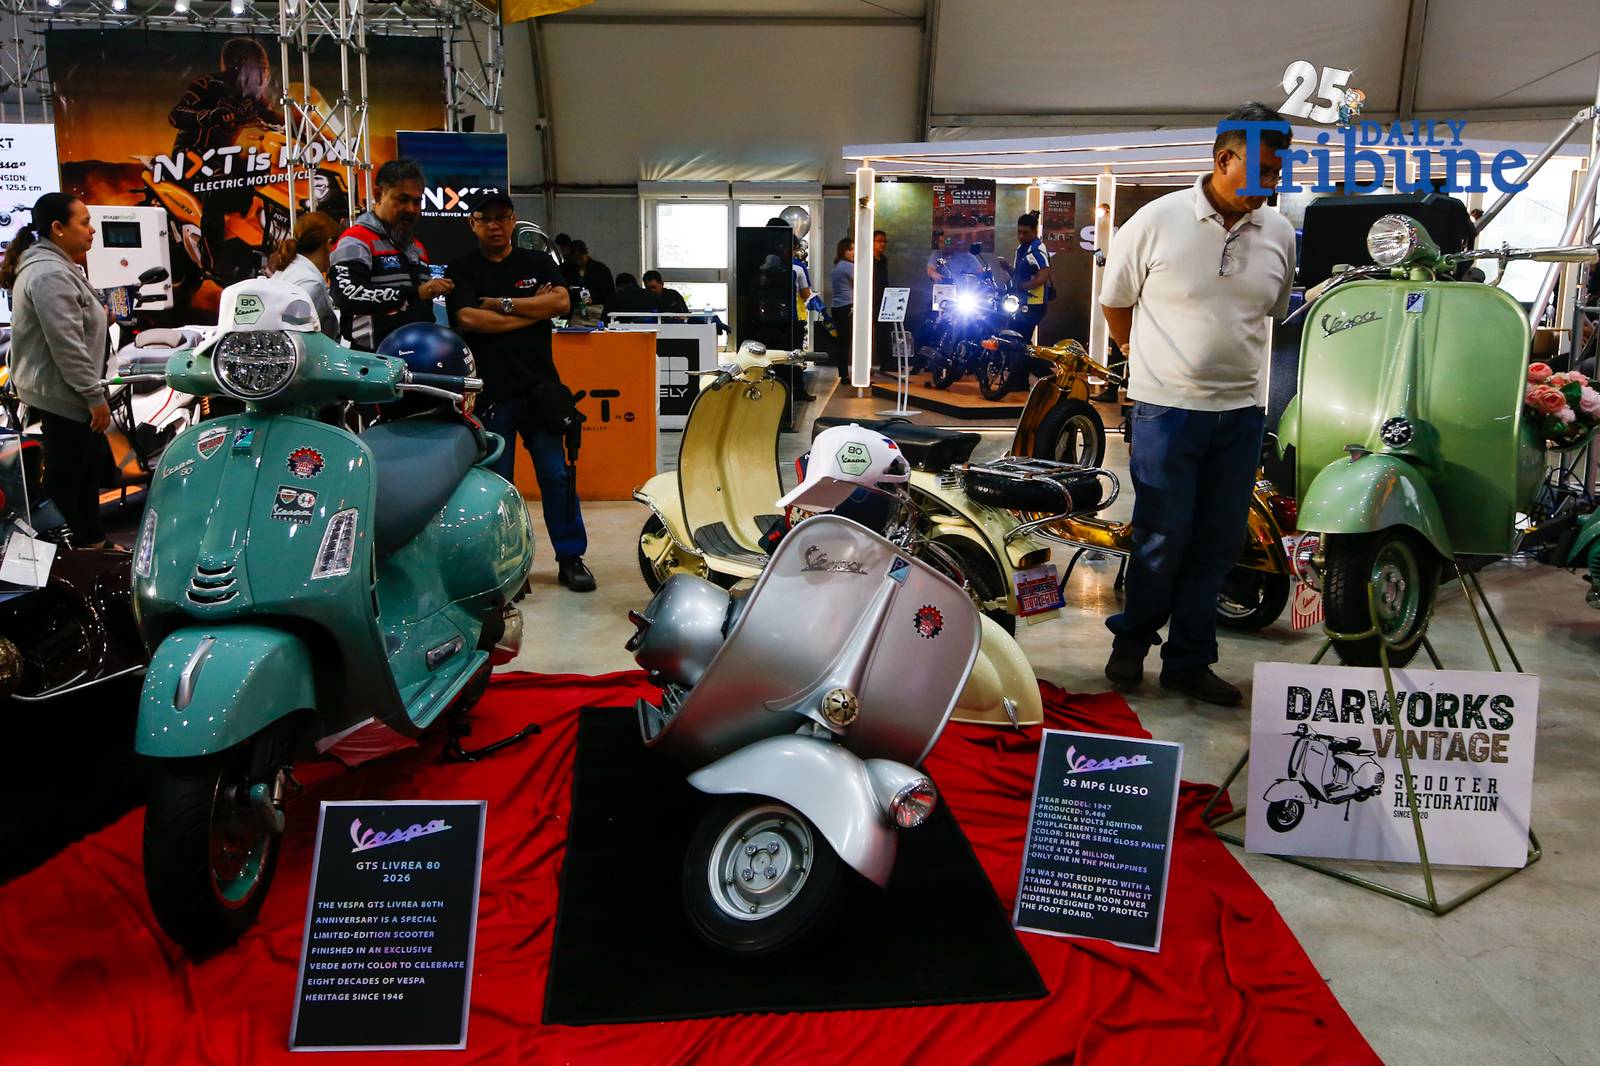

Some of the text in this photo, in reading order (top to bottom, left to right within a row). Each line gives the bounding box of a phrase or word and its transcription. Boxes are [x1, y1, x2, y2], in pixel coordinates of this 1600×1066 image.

[153, 145, 242, 183] NXT
[246, 146, 271, 172] is
[193, 177, 244, 193] ELECTRIC
[1321, 311, 1383, 339] Vespa
[847, 446, 862, 455] 80
[161, 458, 196, 480] Vespa
[273, 503, 312, 516] Vespa
[1285, 685, 1515, 731] DARWORKS
[1372, 728, 1511, 763] VINTAGE
[1066, 745, 1153, 774] Vespa
[1062, 778, 1149, 796] 98 MP6 LUSSO
[1395, 774, 1498, 794] SCOOTER
[1061, 798, 1091, 808] MODEL:
[1093, 803, 1112, 811] 1947
[1394, 792, 1499, 811] RESTORATION
[1393, 810, 1411, 818] SINCE
[1080, 817, 1104, 826] VOLTS
[1106, 820, 1143, 831] IGNITION
[350, 817, 452, 854] Vespa
[1059, 839, 1080, 847] RARE
[1065, 831, 1091, 841] SILVER
[1092, 835, 1112, 843] SEMI
[1113, 837, 1140, 847] GLOSS
[1141, 841, 1165, 851] PAINT
[1062, 847, 1074, 855] TO
[1081, 850, 1115, 860] MILLION
[356, 861, 440, 870] GTS LIVREA 80
[1053, 854, 1070, 862] ONE
[1081, 858, 1097, 866] THE
[1098, 860, 1148, 874] PHILIPPINES
[383, 874, 411, 882] 2026
[1026, 867, 1036, 875] 98
[1037, 869, 1055, 878] WAS
[1057, 871, 1075, 880] NOT
[1076, 874, 1119, 887] EQUIPPED
[1120, 881, 1142, 890] WITH
[1024, 876, 1052, 886] STAND
[1061, 881, 1094, 892] PARKED
[1096, 886, 1107, 894] BY
[1108, 888, 1142, 899] TILTING
[317, 901, 335, 909] THE
[336, 901, 365, 909] VESPA
[367, 901, 385, 909] GTS
[1023, 884, 1146, 909] ALUMINUM HALF MOON OVER
[1020, 901, 1095, 919] THE FOOT BOARD.
[1021, 893, 1149, 918] RIDERS DESIGNED TO PROTECT
[315, 916, 379, 924] ANNIVERSARY
[400, 915, 438, 923] SPECIAL
[313, 931, 391, 939] LIMITED-EDITION
[384, 946, 433, 954] EXCLUSIVE
[309, 961, 464, 970] VERDE 80TH COLOR TO CELEBRATE
[307, 977, 425, 986] EIGHT DECADES OF VESPA
[305, 993, 350, 1001] HERITAGE
[352, 993, 379, 1001] SINCE
